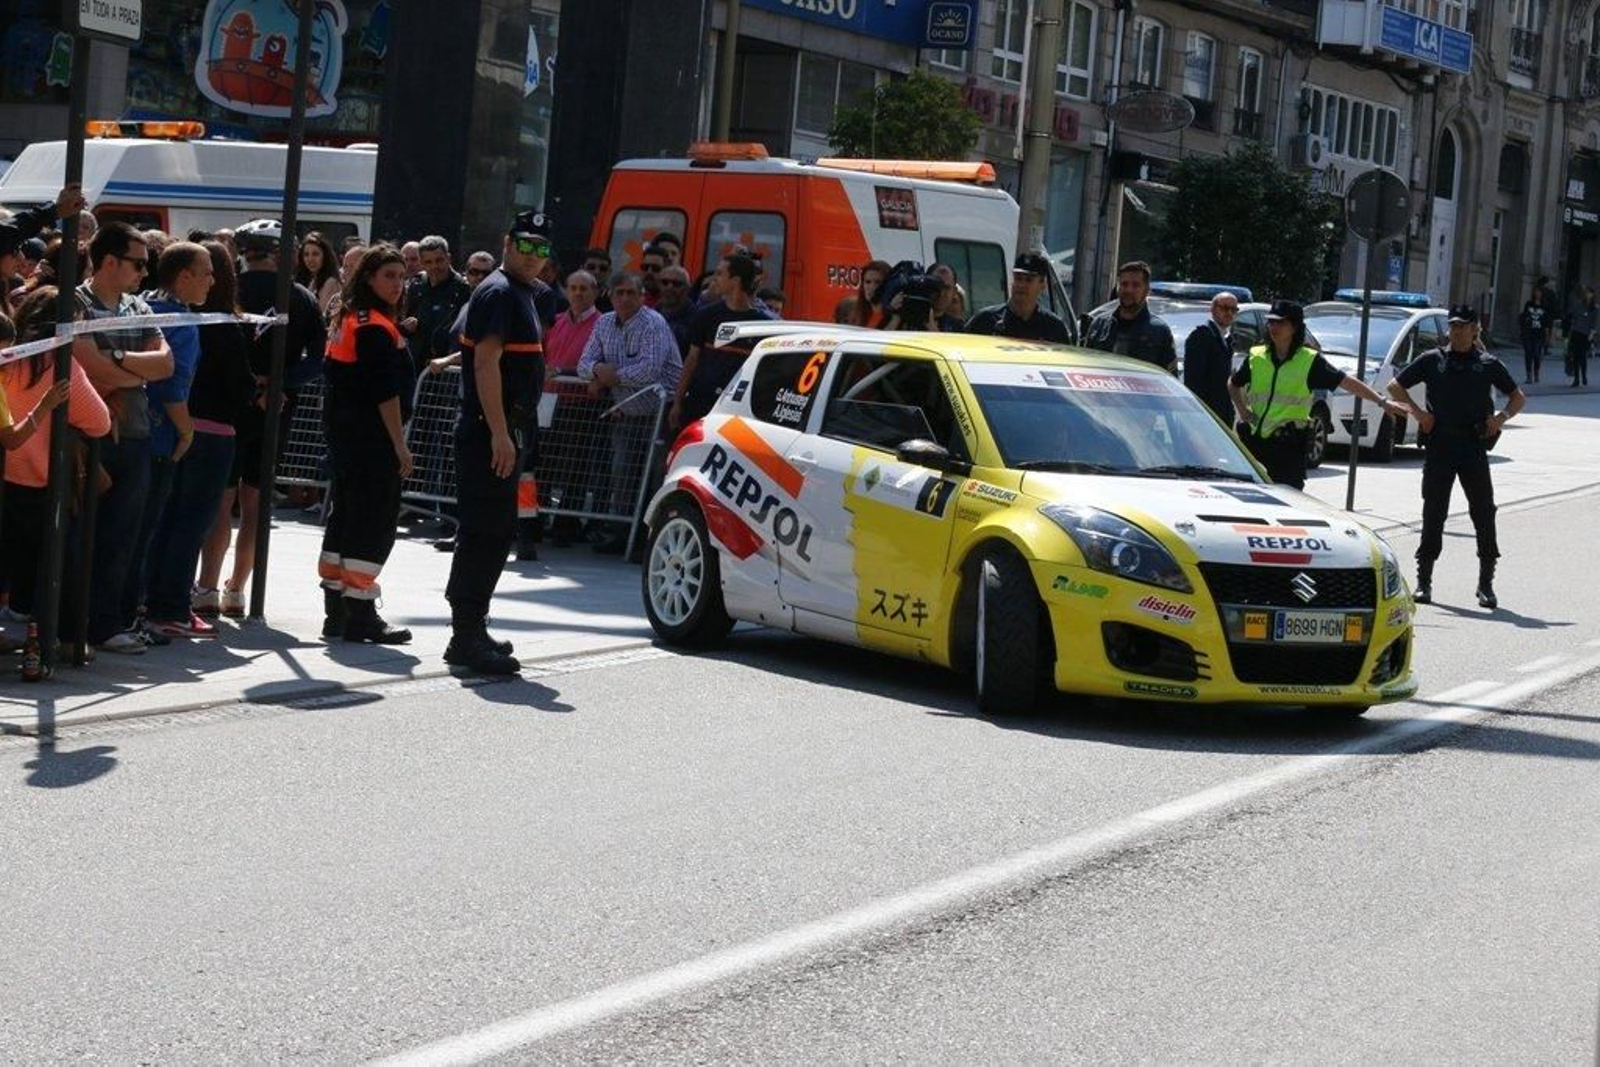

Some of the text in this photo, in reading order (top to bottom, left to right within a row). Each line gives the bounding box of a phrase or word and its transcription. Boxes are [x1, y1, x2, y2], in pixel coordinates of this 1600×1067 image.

[93, 0, 109, 18] TODA
[111, 4, 118, 20] A
[119, 6, 139, 25] PRAZA
[930, 29, 964, 39] OCASO
[1415, 19, 1439, 52] ICA
[797, 351, 826, 394] 6
[1073, 373, 1130, 391] Suzuki
[699, 443, 813, 563] REPSOL
[926, 481, 945, 513] 6
[978, 483, 1018, 502] SUZUKI
[1247, 536, 1332, 551] REPSOL
[871, 588, 929, 628] スズキ
[1138, 595, 1196, 620] disiclin
[1246, 616, 1266, 626] RACC
[1285, 618, 1317, 637] 8699
[1320, 618, 1343, 637] HGN
[1258, 685, 1342, 696] www.suzuki.es
